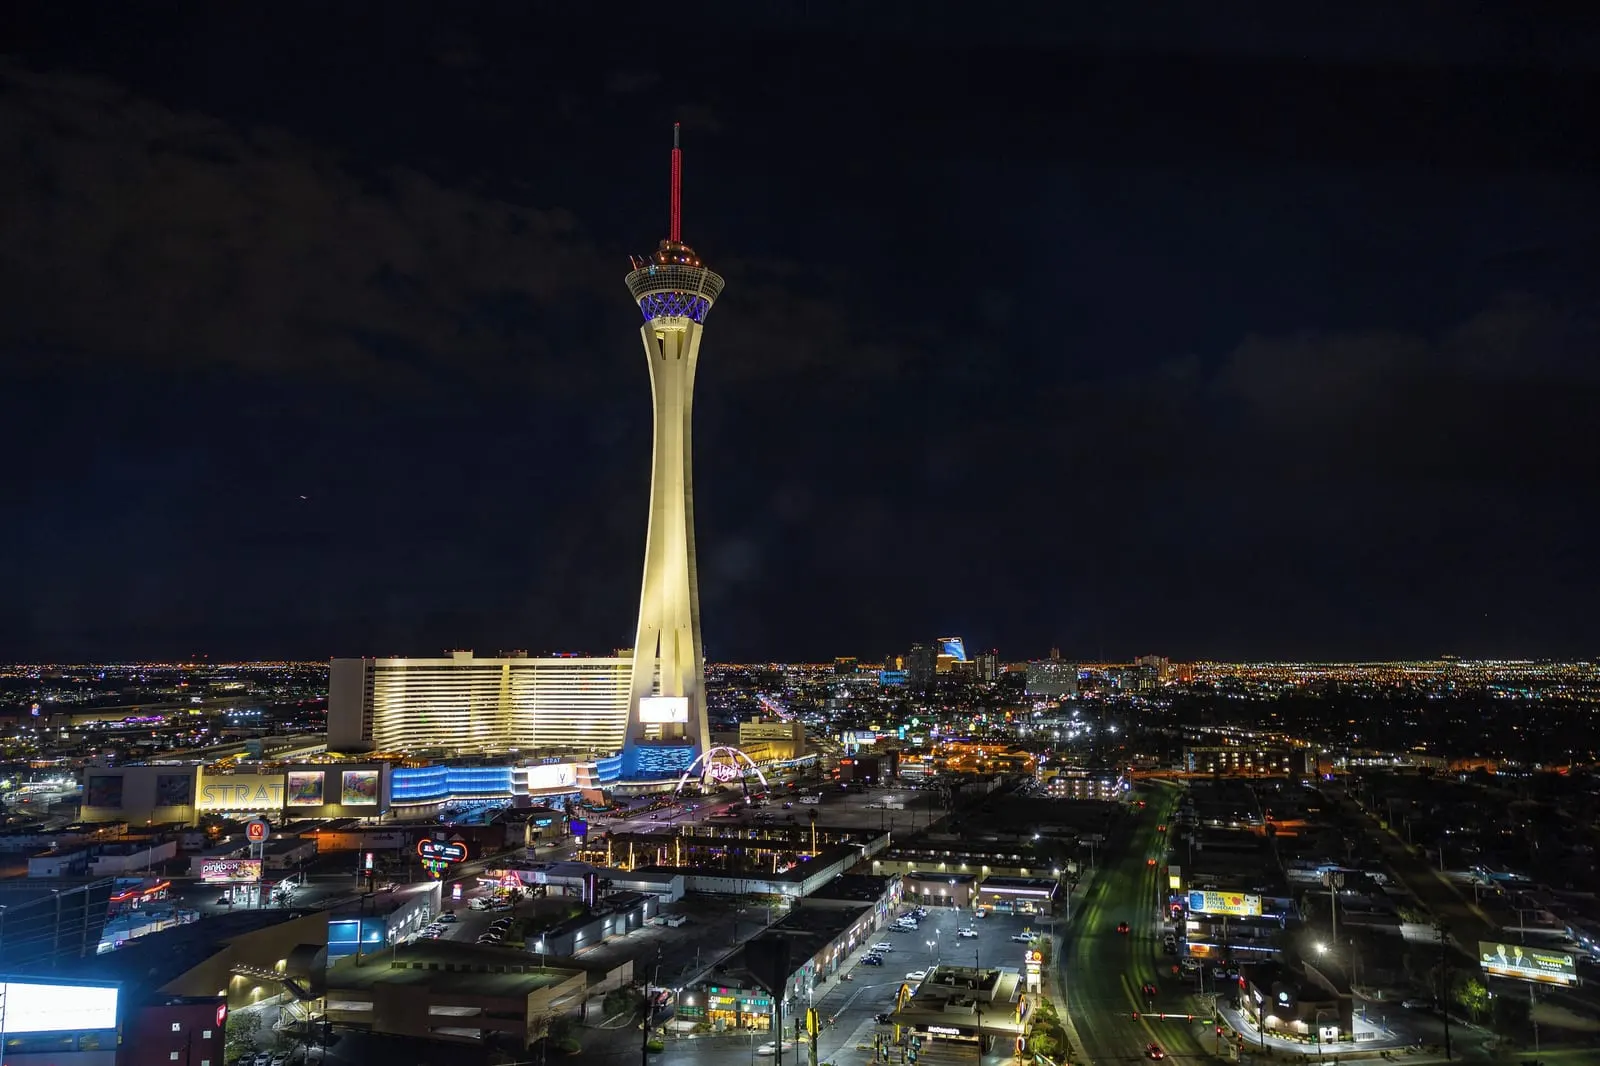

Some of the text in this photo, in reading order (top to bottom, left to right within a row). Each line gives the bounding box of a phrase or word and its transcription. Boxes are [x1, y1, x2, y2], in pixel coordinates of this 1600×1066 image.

[201, 784, 284, 806] STRAT
[203, 862, 238, 873] pinkbox
[928, 1026, 960, 1035] McDonald's
